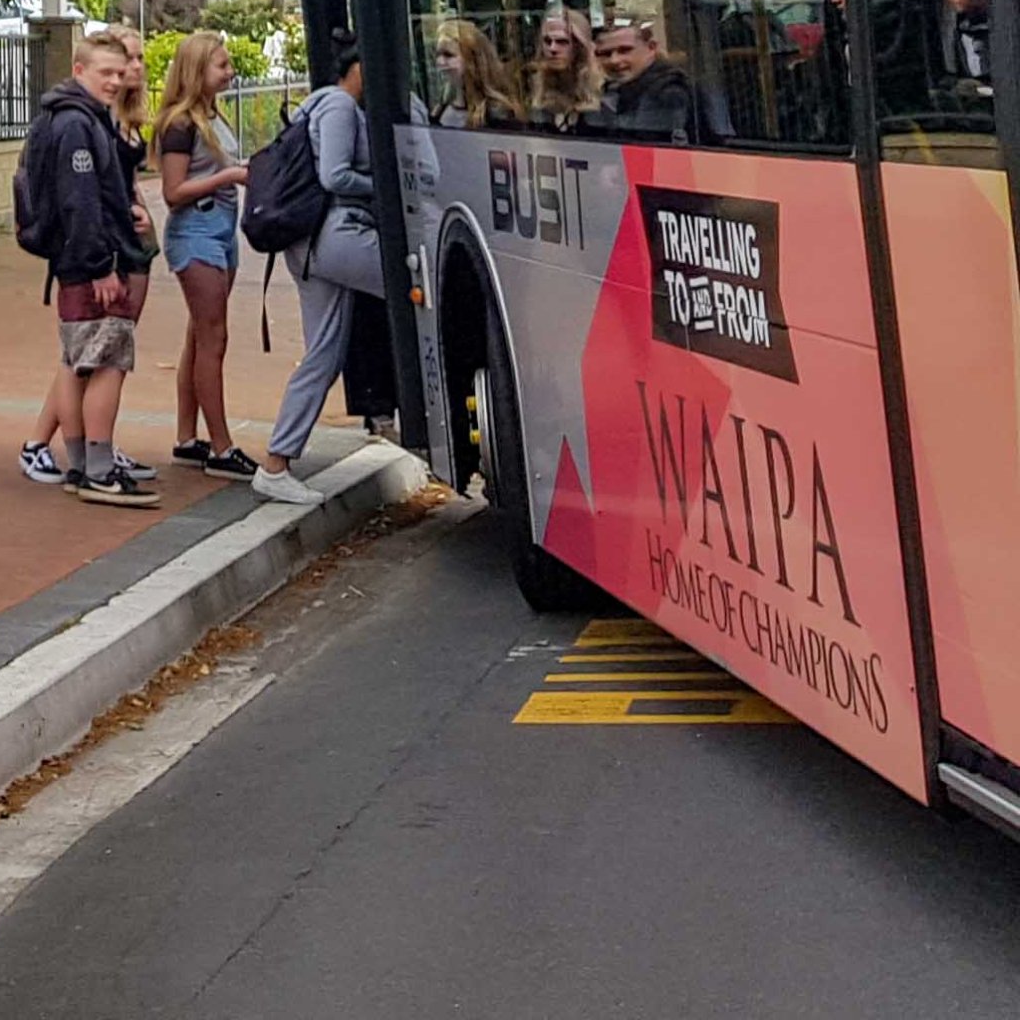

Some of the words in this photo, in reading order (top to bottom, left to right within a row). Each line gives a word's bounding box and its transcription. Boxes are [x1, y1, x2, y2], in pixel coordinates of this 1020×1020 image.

[488, 149, 589, 251] BUSIT
[657, 210, 761, 279] TRAVELLING
[663, 269, 691, 326] TO
[692, 288, 713, 319] AND
[712, 280, 771, 349] FROM
[636, 380, 862, 629] WAIPA
[646, 527, 710, 624] HOME
[708, 573, 735, 638] OF
[739, 590, 889, 735] CHAMPIONS
